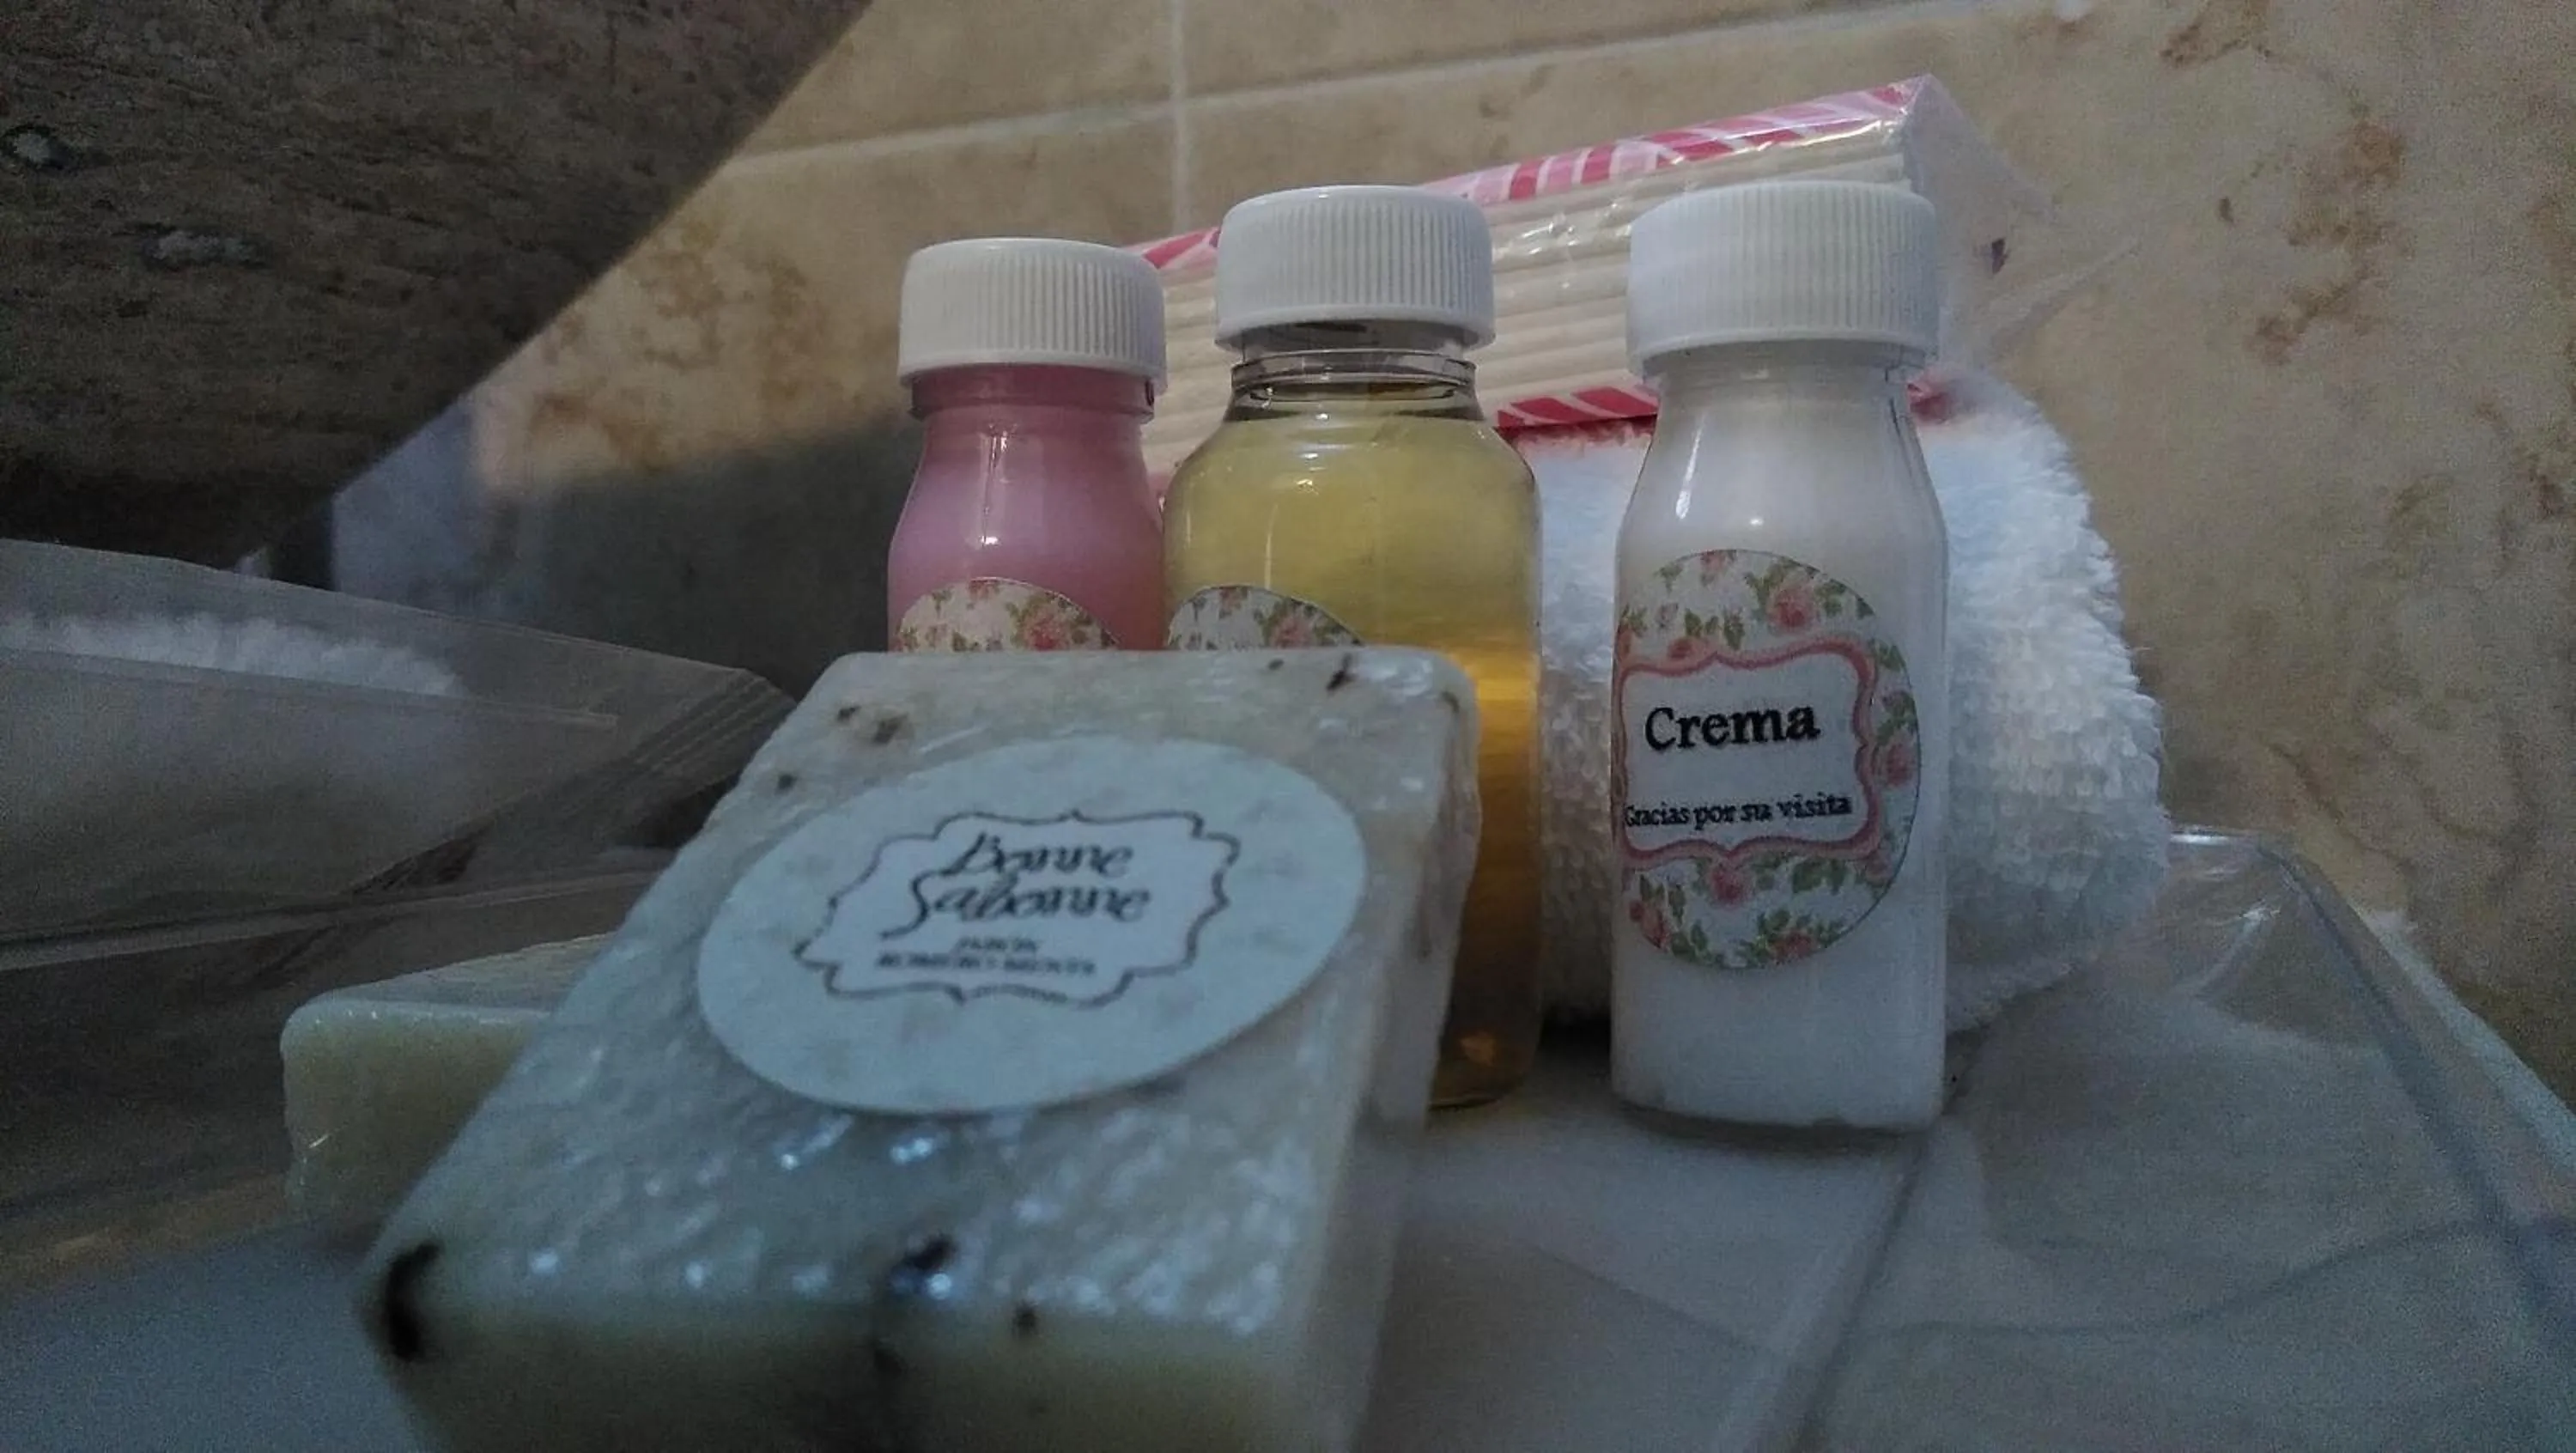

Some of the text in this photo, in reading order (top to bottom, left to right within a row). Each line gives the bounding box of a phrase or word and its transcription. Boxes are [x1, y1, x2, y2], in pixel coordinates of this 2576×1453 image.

[1643, 706, 1821, 751] Crema
[1624, 792, 1852, 831] Gracias por su visita
